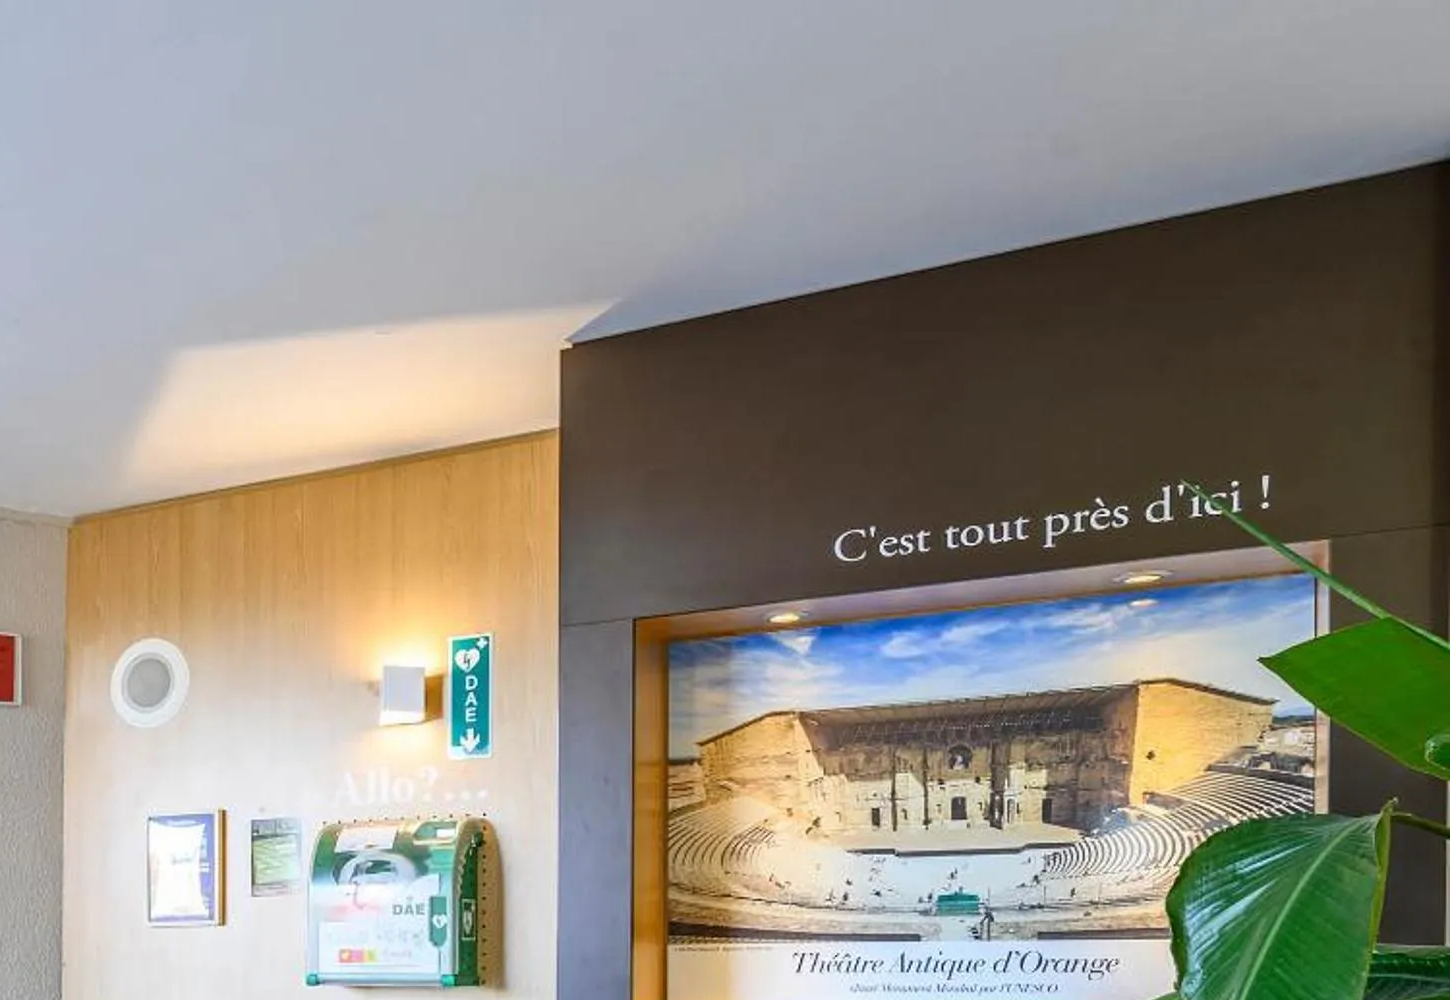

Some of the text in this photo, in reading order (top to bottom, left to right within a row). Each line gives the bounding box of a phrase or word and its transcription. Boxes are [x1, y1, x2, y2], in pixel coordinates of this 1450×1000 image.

[834, 475, 1271, 562] C'est tout près d'ici !
[465, 675, 479, 723] DAE
[391, 903, 426, 916] DAE
[792, 949, 1119, 980] Théâtre Antique d'Orange
